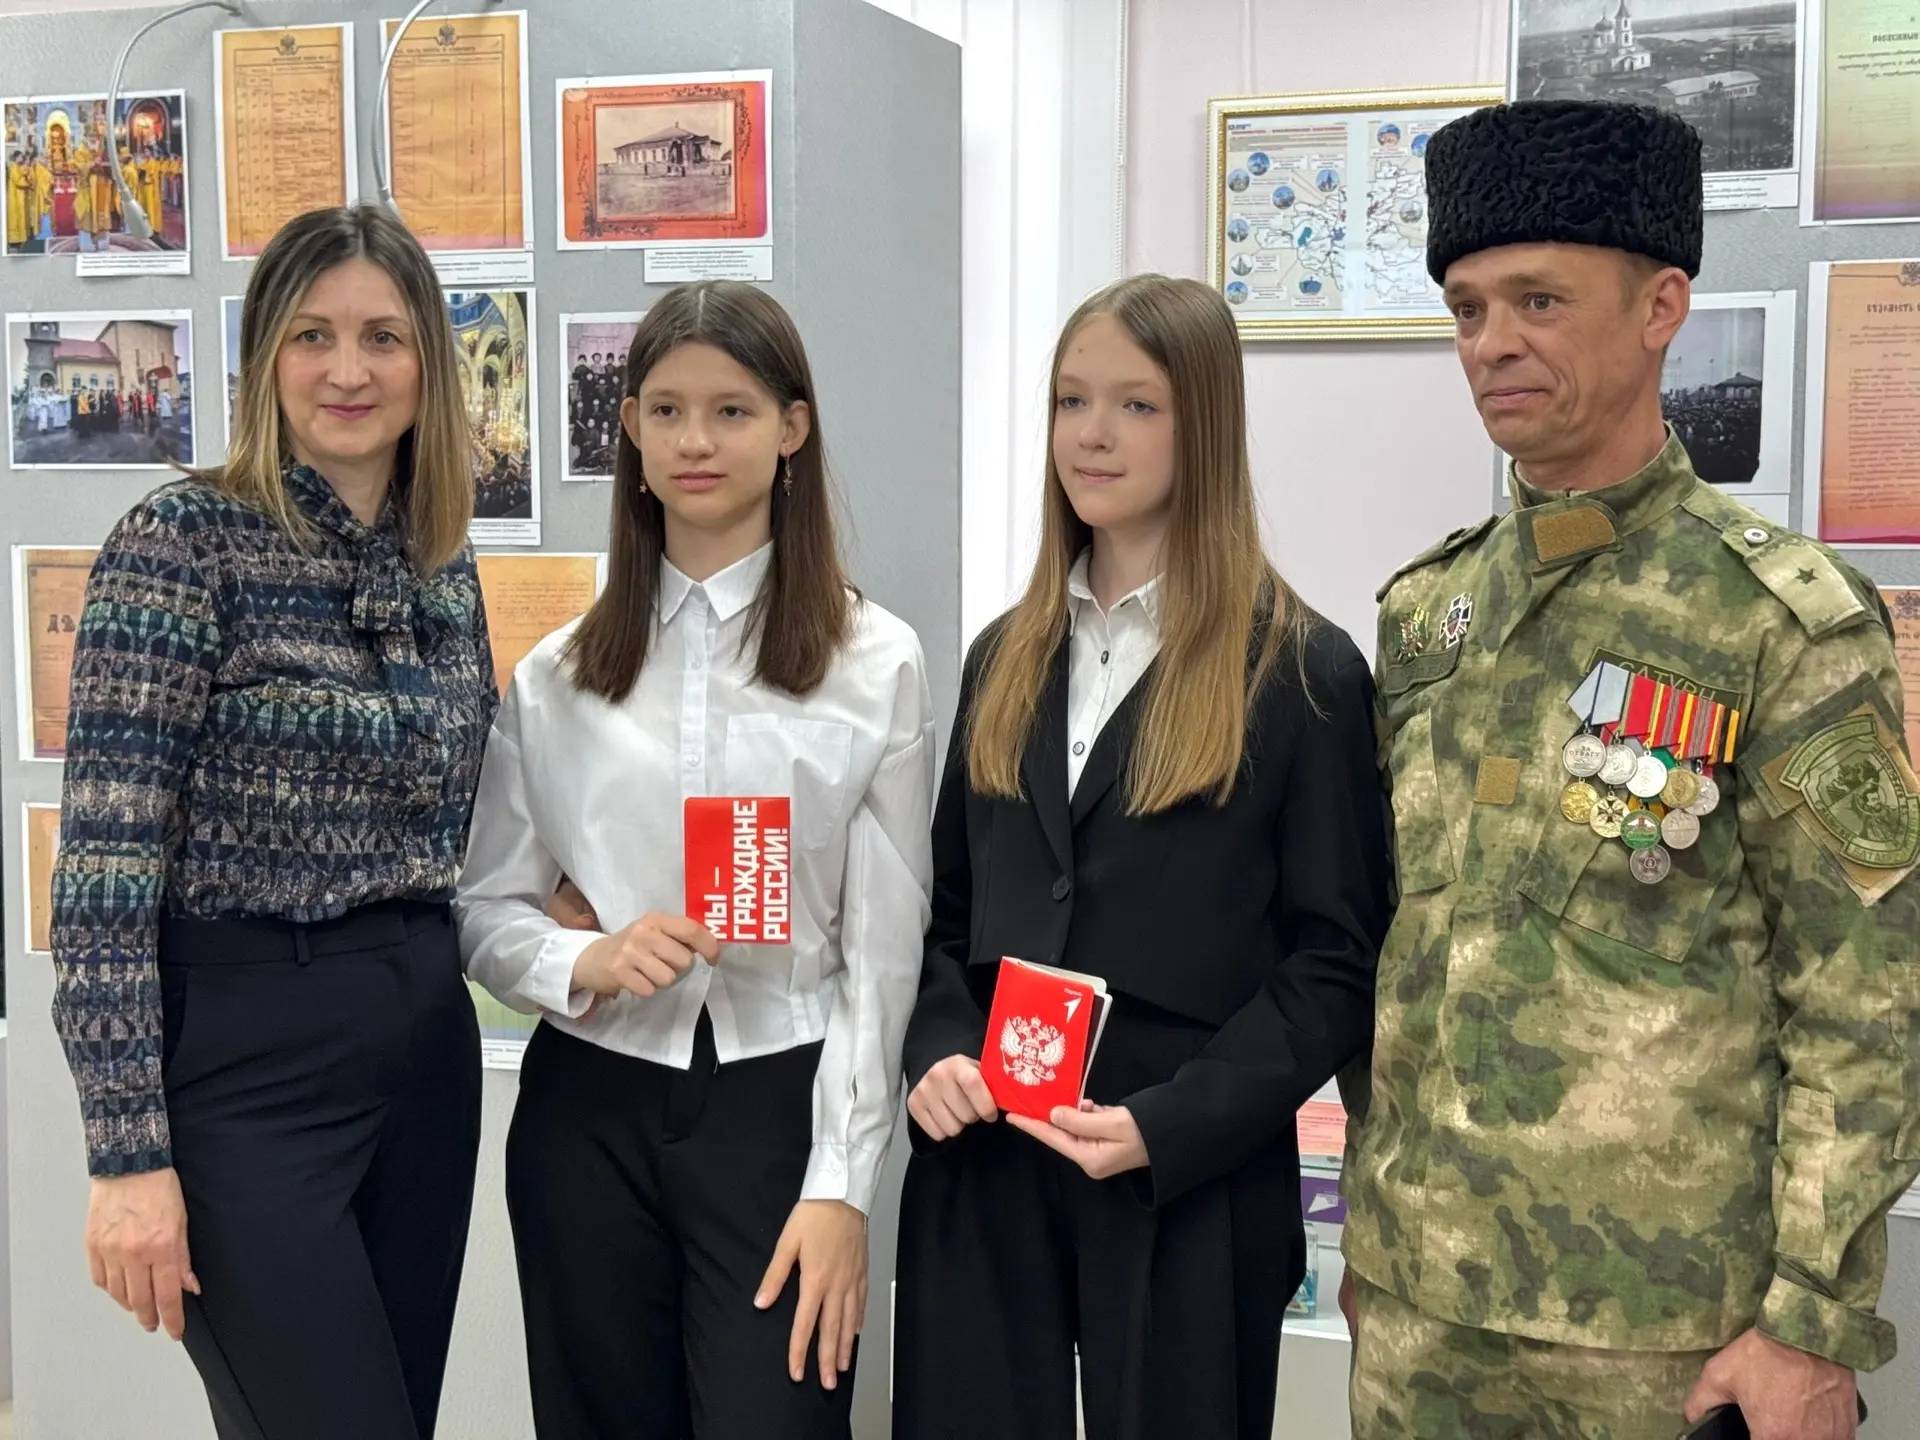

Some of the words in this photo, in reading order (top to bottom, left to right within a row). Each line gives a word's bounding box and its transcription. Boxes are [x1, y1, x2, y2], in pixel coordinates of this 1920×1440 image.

[704, 894, 728, 940] МЫ
[733, 800, 760, 940] ГРАЖДАНЕ
[763, 827, 788, 940] РОССИИ!
